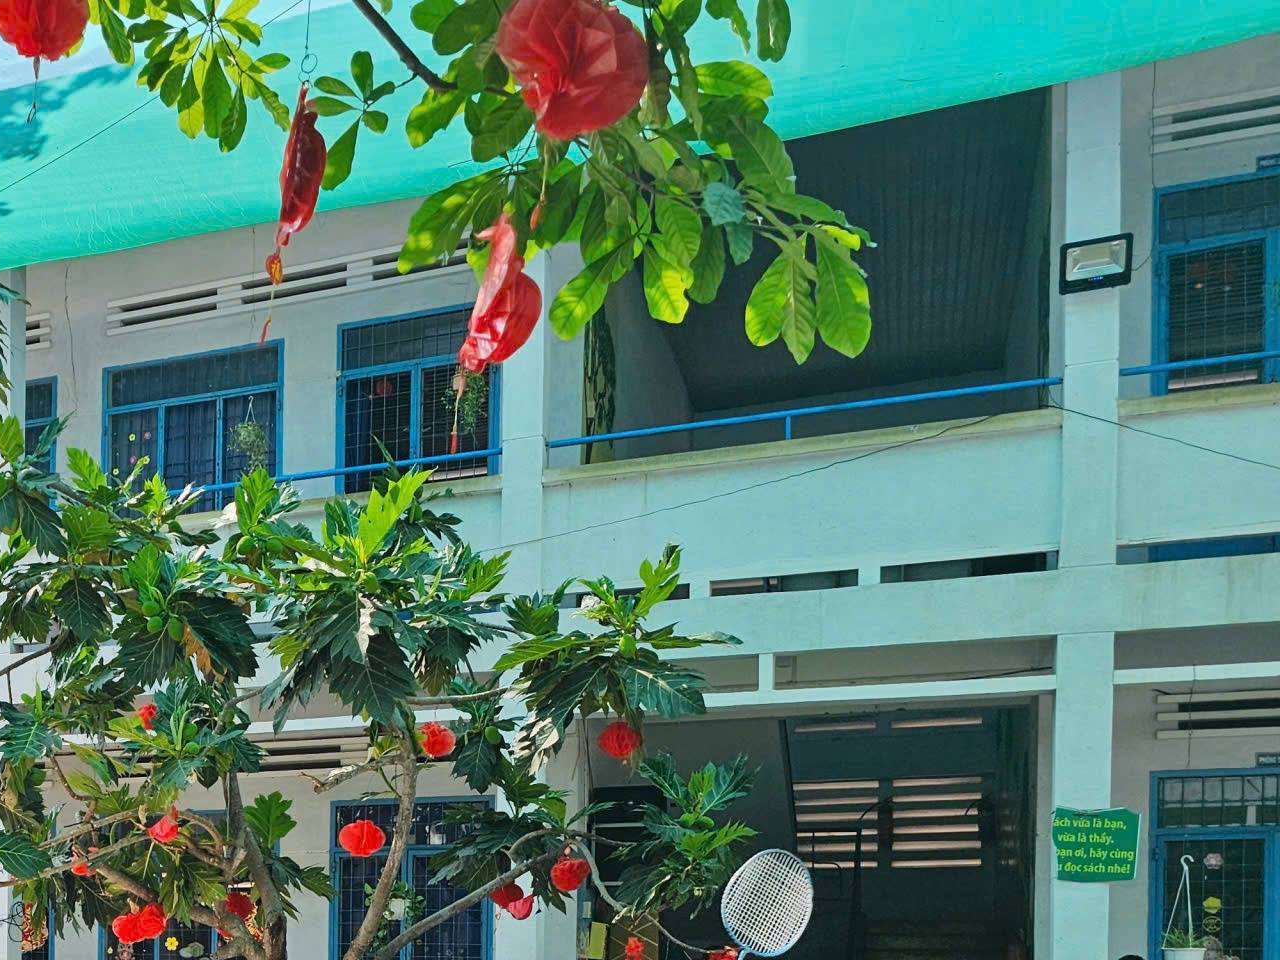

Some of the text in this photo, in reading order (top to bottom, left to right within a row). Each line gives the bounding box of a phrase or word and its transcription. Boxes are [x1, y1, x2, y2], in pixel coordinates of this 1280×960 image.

[1053, 817, 1127, 831] ách vừa là bạn,
[1057, 831, 1076, 842] vừa
[1077, 832, 1087, 843] là
[1074, 847, 1087, 859] ơi,
[1089, 847, 1108, 860] hãy
[1109, 848, 1135, 861] cùng
[1064, 861, 1082, 874] đọc
[1083, 862, 1106, 873] sách
[1107, 863, 1130, 874] nhé!
